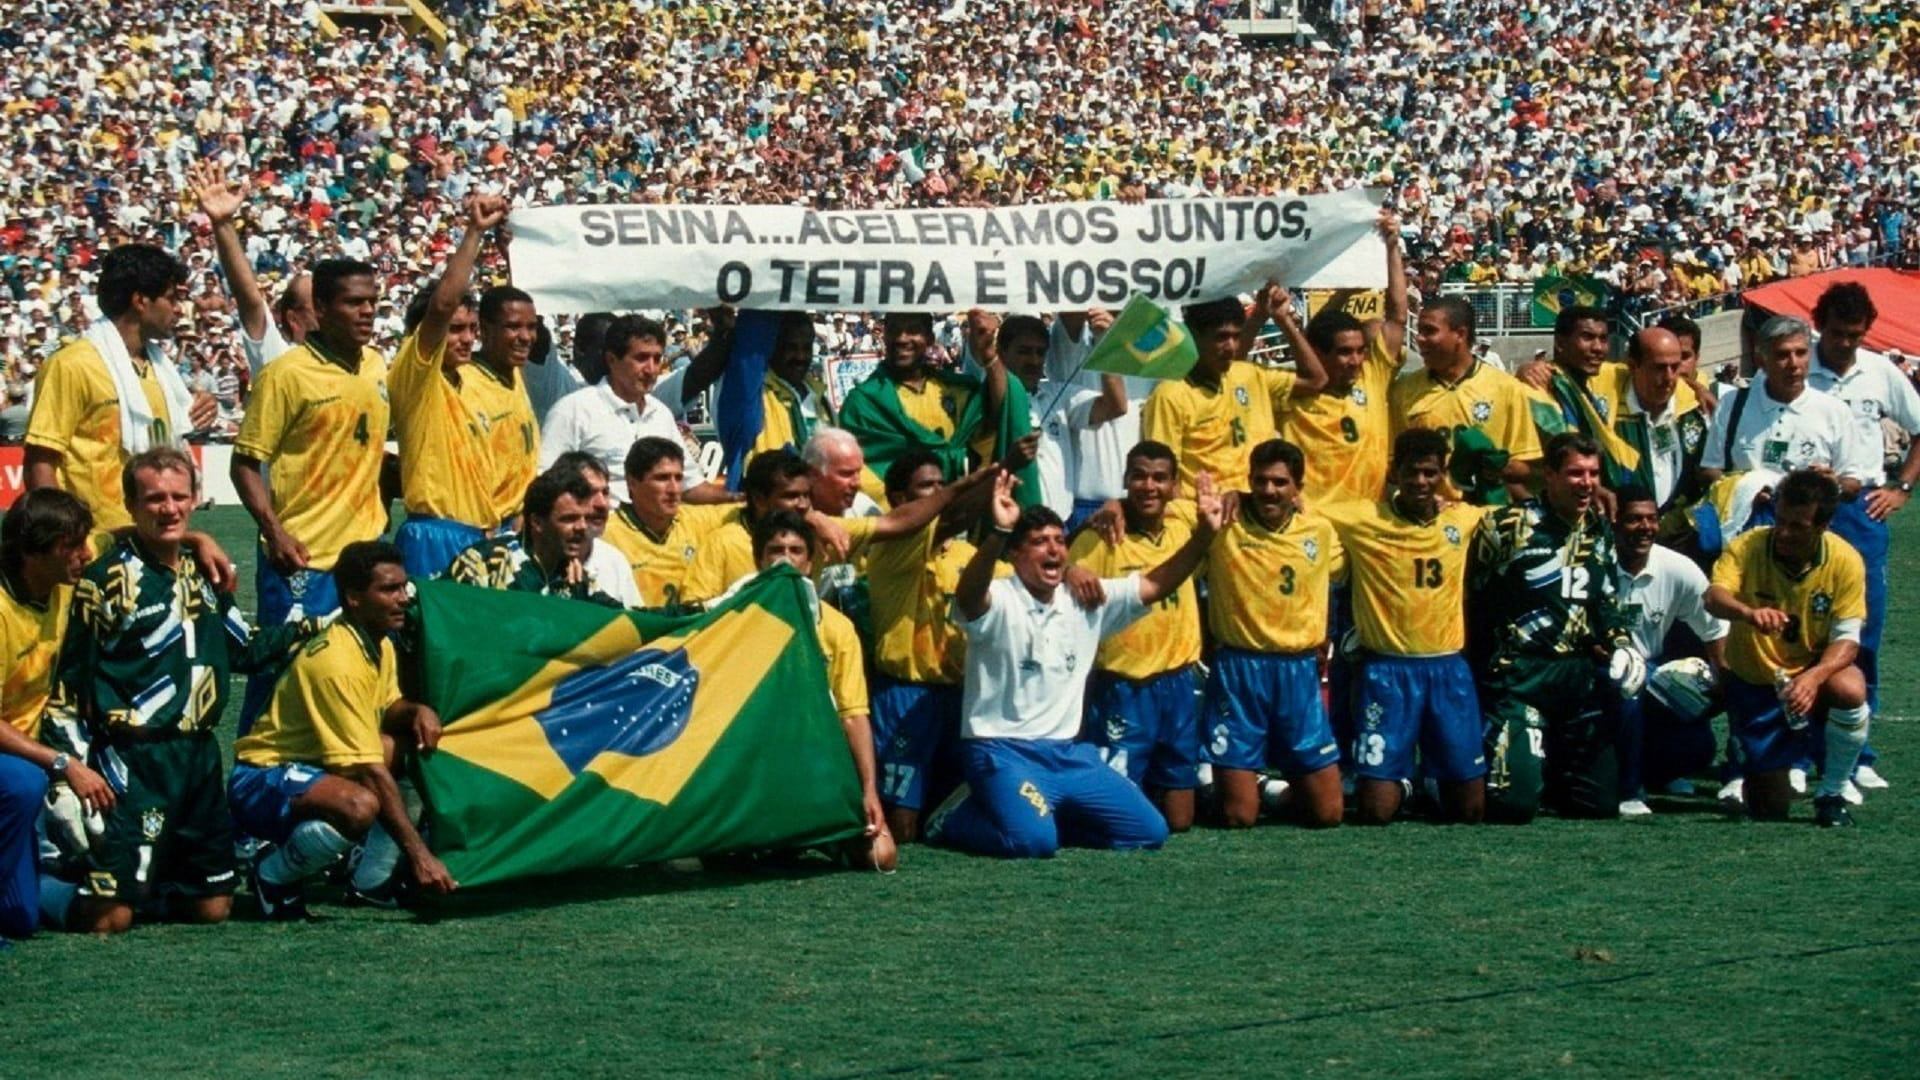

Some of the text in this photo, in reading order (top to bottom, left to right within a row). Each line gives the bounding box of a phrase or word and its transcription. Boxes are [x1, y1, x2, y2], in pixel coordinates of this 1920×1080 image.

[1137, 200, 1312, 243] JUNTOS,
[716, 250, 1206, 305] O TETRA É NOSSO!
[1343, 296, 1378, 315] ENA
[353, 412, 370, 447] 4
[1340, 415, 1359, 443] 9
[1278, 564, 1296, 596] 3
[1413, 557, 1443, 589] 13
[1561, 566, 1590, 599] 12
[1211, 723, 1230, 756] 3
[1358, 733, 1386, 766] 13
[884, 764, 915, 798] 17
